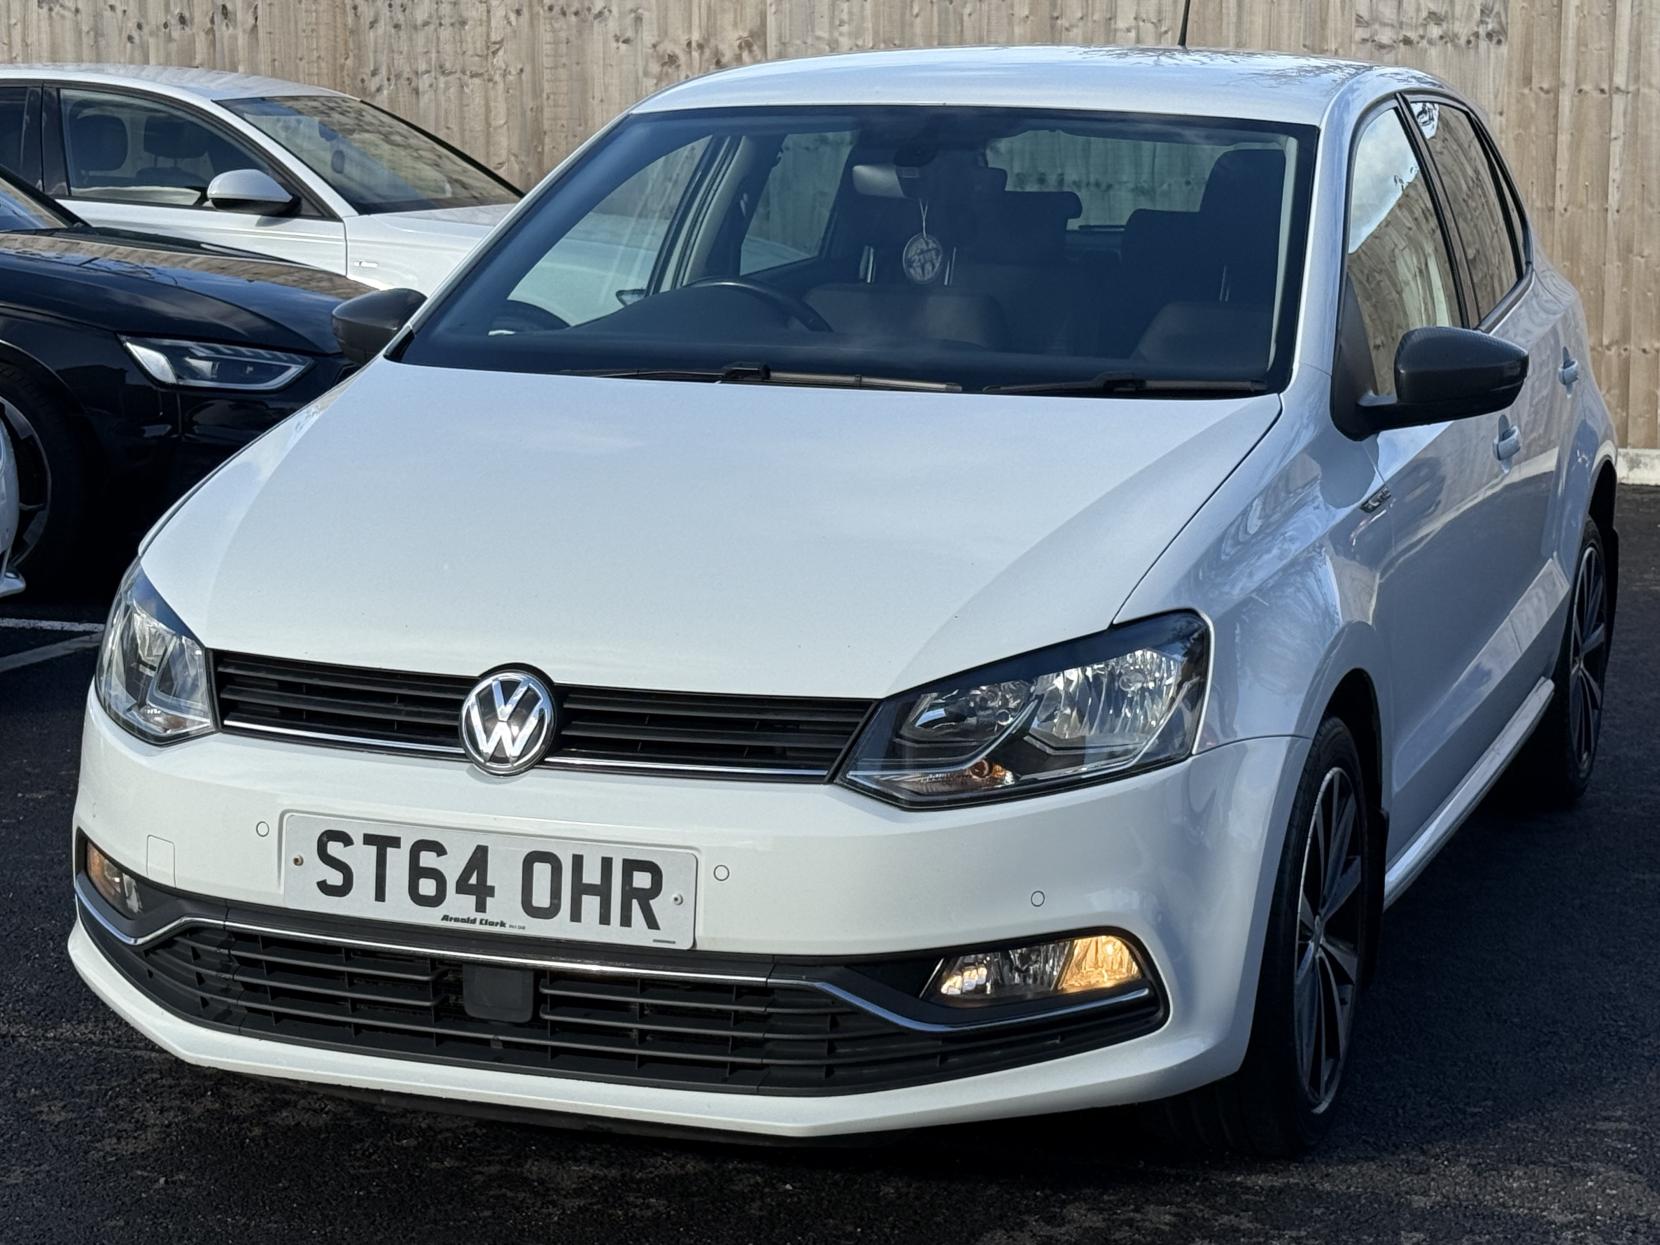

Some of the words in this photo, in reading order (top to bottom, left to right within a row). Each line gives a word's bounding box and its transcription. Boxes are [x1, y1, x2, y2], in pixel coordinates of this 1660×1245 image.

[463, 674, 550, 768] VW
[316, 829, 495, 914] ST64
[521, 850, 663, 931] OHR
[441, 914, 477, 925] Arnold
[479, 918, 506, 928] Clark
